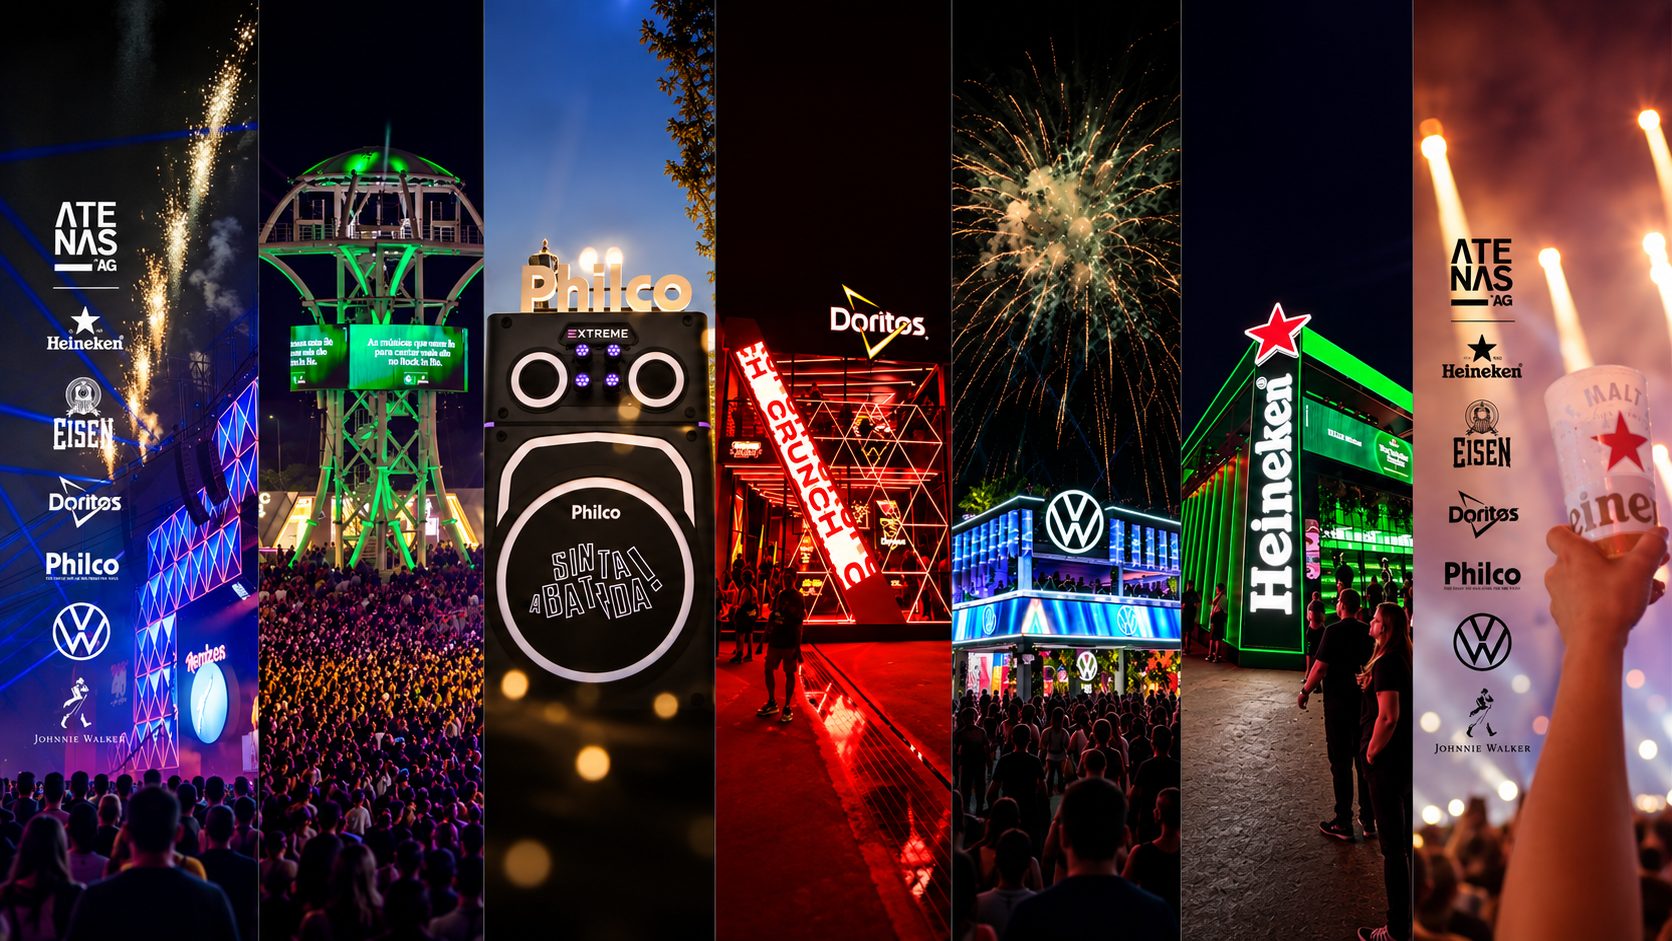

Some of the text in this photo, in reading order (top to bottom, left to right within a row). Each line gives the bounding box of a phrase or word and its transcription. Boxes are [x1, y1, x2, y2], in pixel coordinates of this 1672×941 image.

[520, 263, 693, 313] Philco
[567, 328, 629, 339] EXTREME
[830, 306, 926, 336] Doritos
[1584, 382, 1642, 407] MALT
[766, 399, 844, 538] CRUNCH
[1249, 372, 1293, 615] Heineken
[571, 504, 621, 520] Philco
